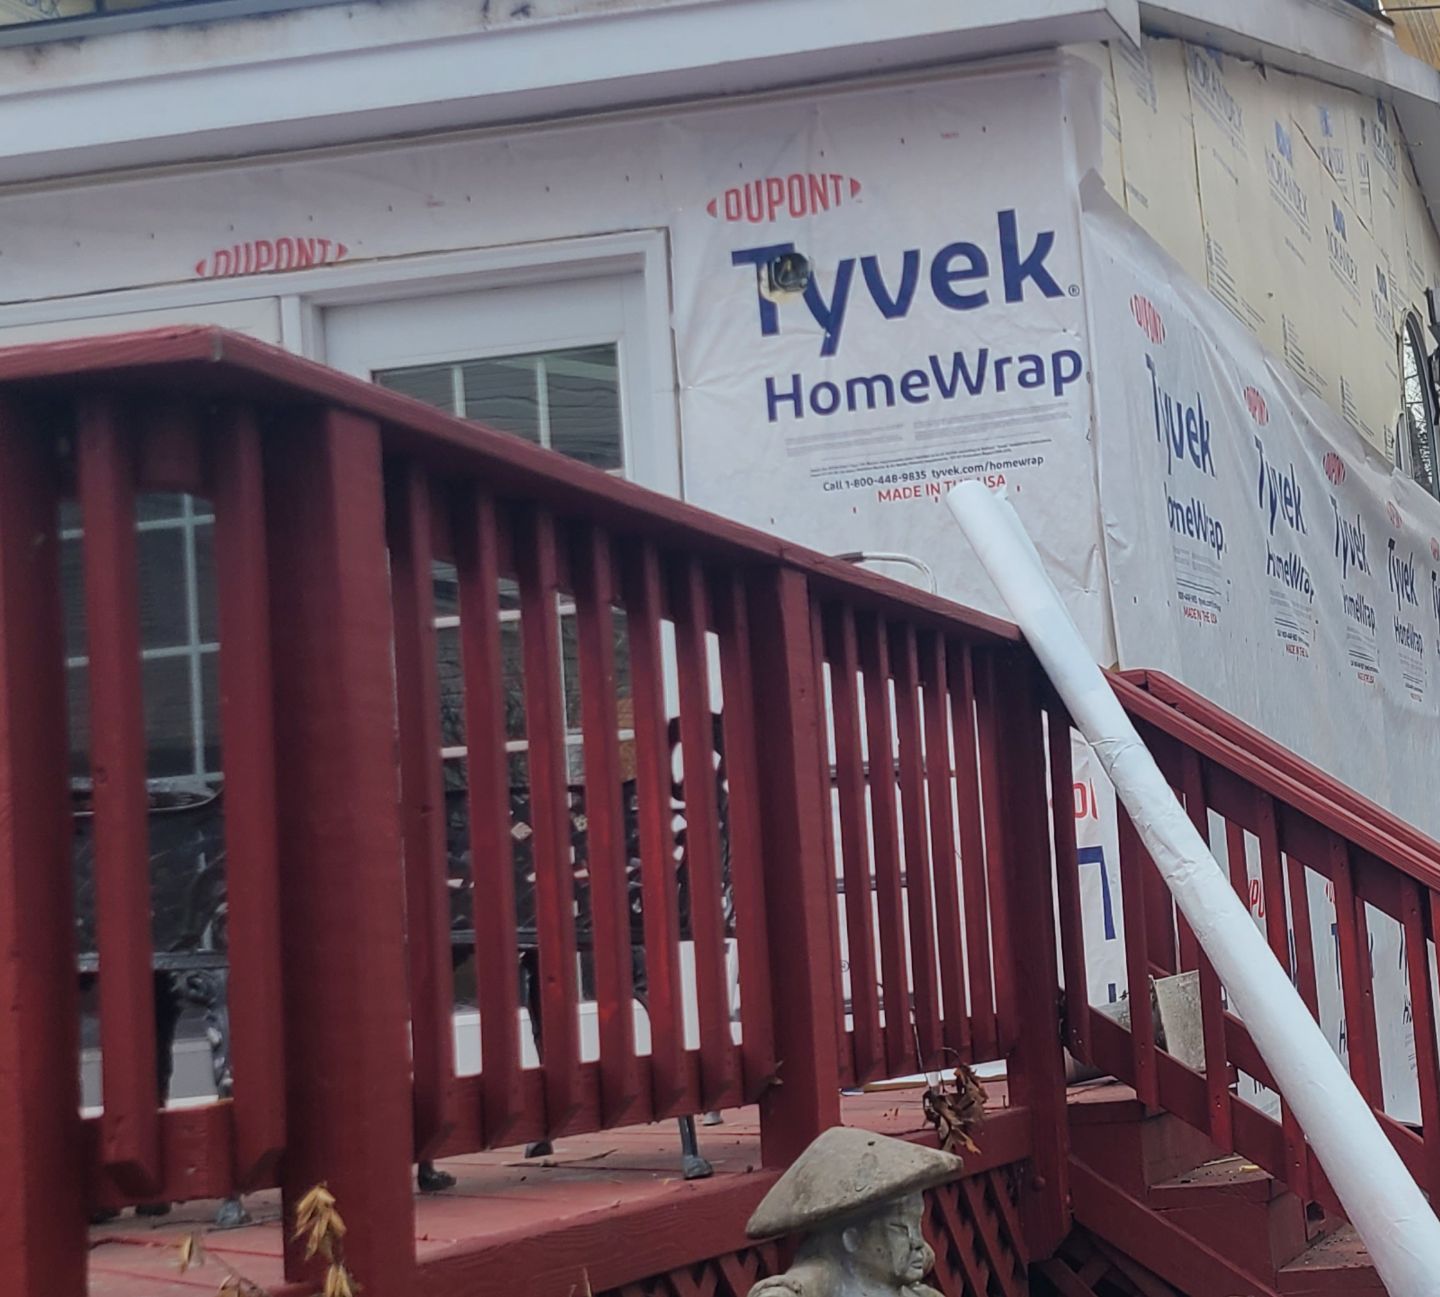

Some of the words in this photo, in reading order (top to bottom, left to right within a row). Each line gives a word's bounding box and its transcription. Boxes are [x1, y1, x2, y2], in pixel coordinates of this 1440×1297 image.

[724, 172, 845, 223] DUPONT
[212, 237, 333, 277] DUPONT
[764, 347, 1083, 422] HomeWrap
[823, 480, 843, 492] Call
[845, 470, 927, 489] 1-800-448-9835
[931, 456, 1044, 479] tyvek.com/homewrap
[877, 485, 922, 503] MADE
[926, 482, 940, 497] IN
